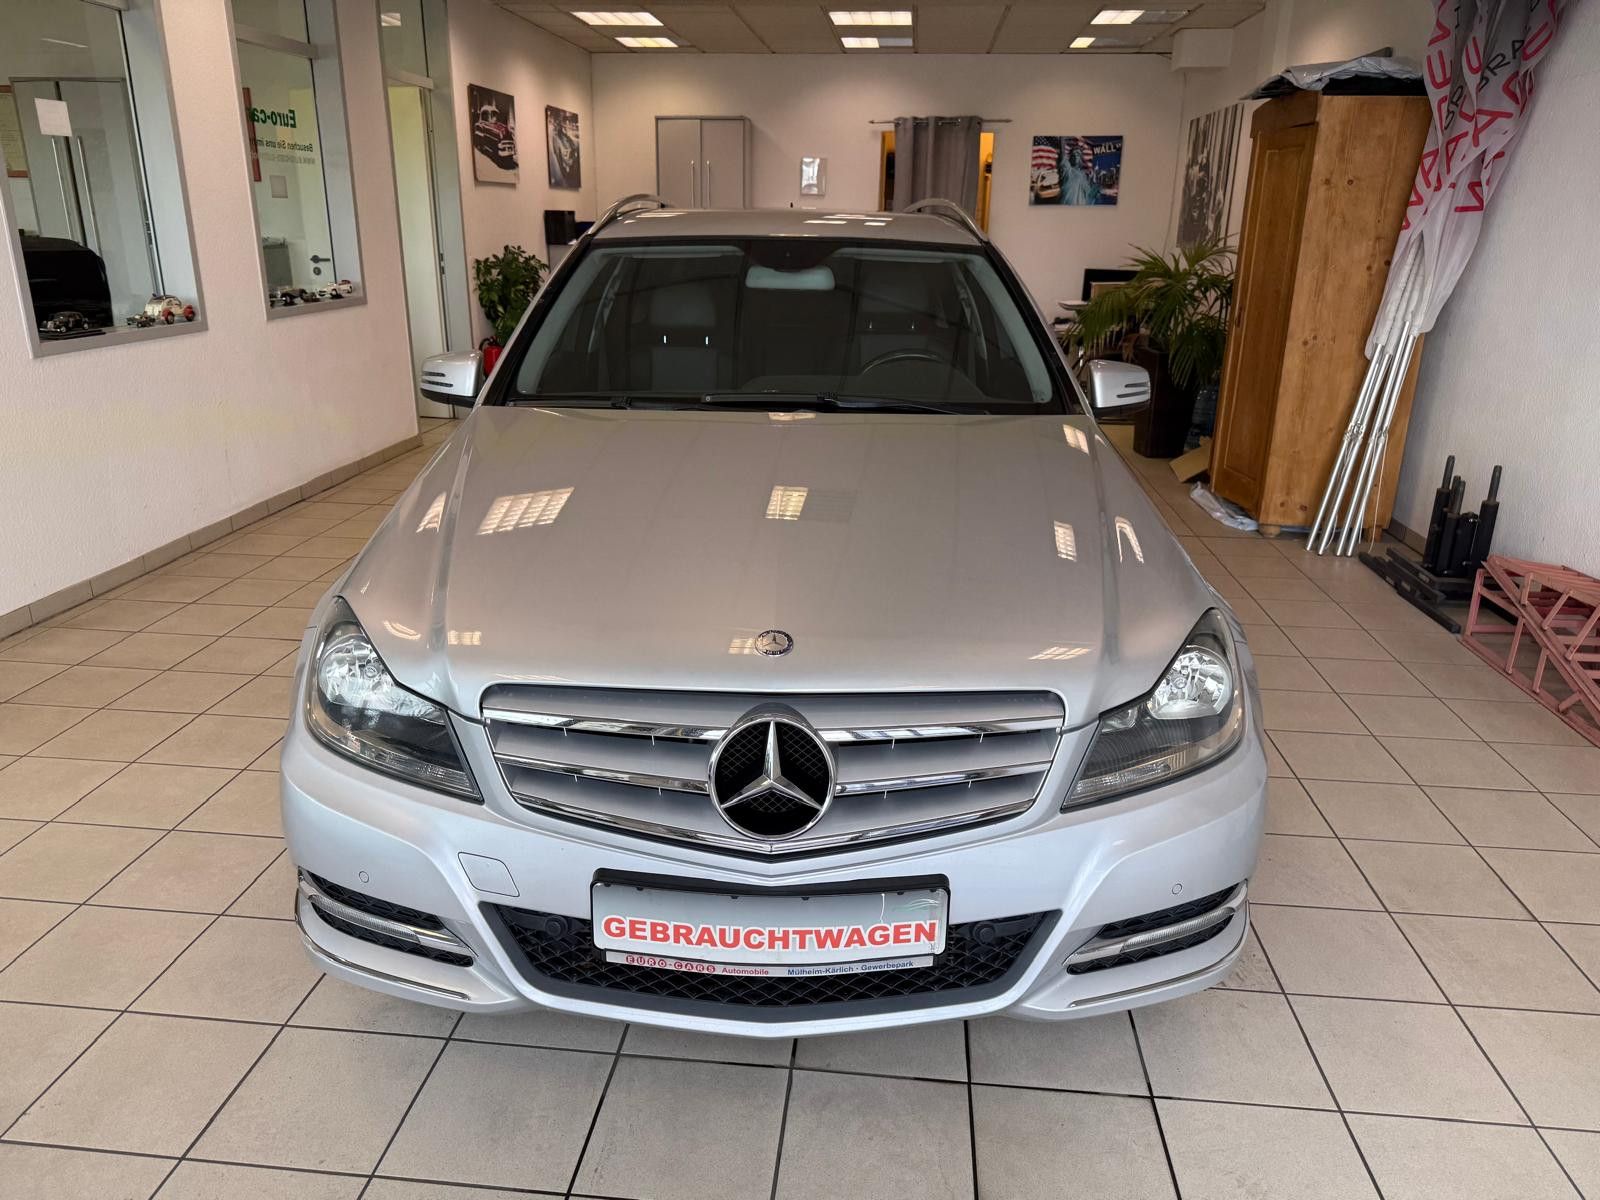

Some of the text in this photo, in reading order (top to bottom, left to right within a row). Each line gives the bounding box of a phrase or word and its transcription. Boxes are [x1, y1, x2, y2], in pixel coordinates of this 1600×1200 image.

[1094, 142, 1116, 154] WALL
[602, 917, 938, 950] GEBRAUCHTWAGEN
[721, 966, 769, 976] Automobile
[787, 965, 854, 976] Mülheim-Kärlich
[861, 960, 914, 971] Gewerbepark
